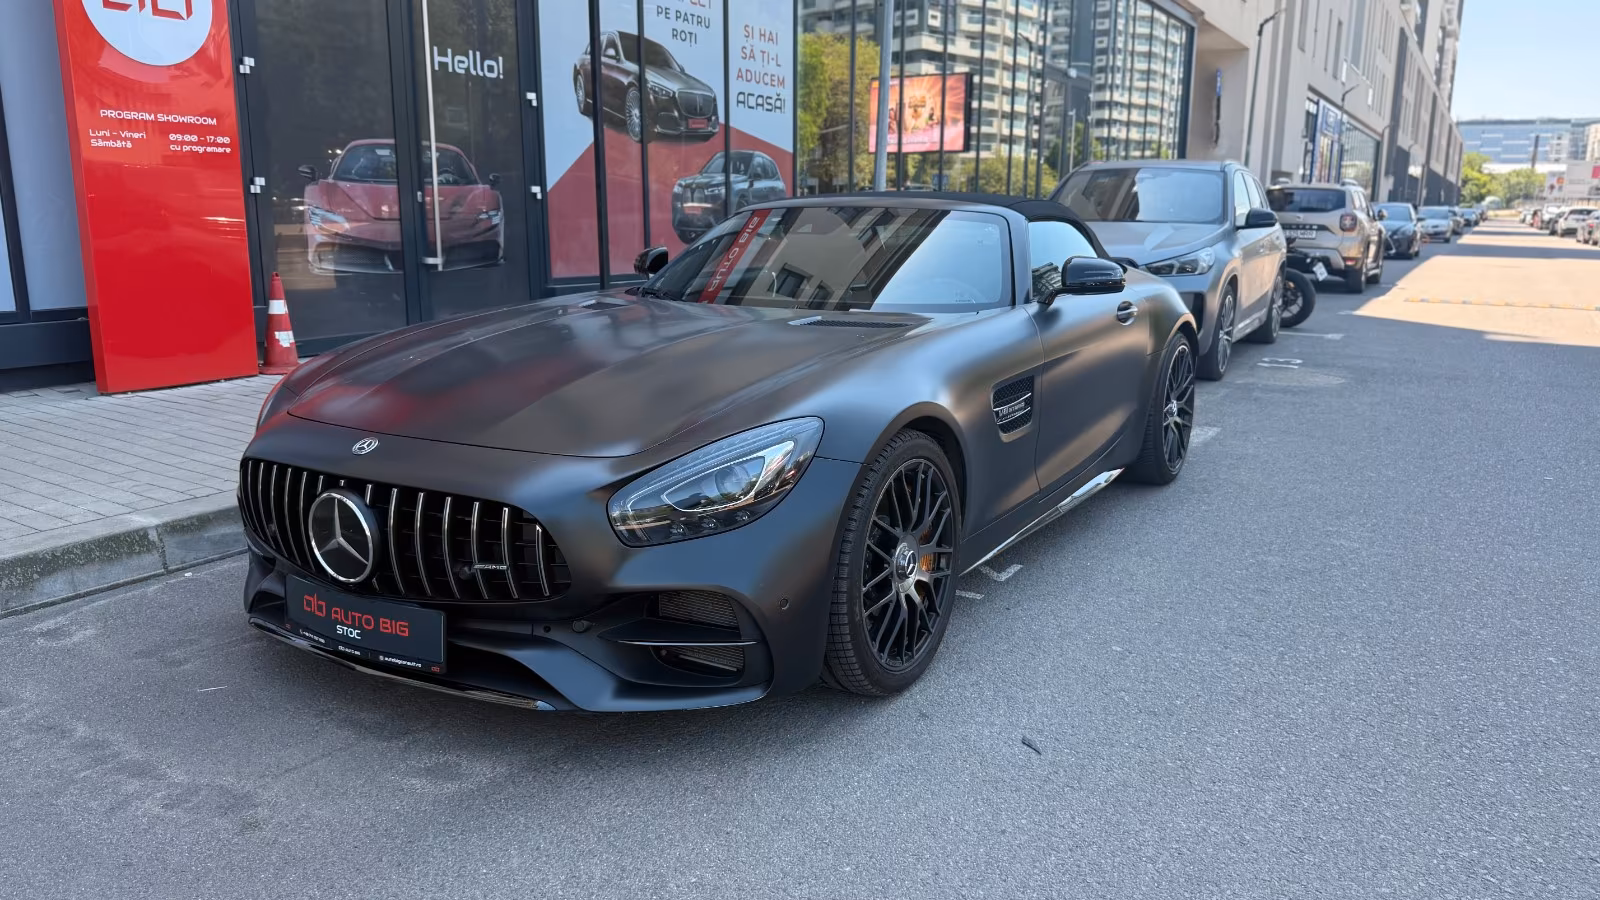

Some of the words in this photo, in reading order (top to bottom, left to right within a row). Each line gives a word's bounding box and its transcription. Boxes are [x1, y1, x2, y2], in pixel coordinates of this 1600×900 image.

[656, 5, 671, 20] PE
[675, 10, 711, 29] PATRU
[671, 27, 697, 47] ROȚI
[743, 24, 754, 42] ȘI
[759, 27, 778, 46] HAI
[433, 46, 504, 79] Hello!
[741, 44, 756, 62] SĂ
[736, 67, 785, 89] ADUCEM
[736, 91, 786, 114] ACASĂ!
[100, 109, 155, 121] PROGRAM
[157, 114, 217, 126] SHOWROOM
[89, 129, 110, 137] Luni
[119, 130, 146, 140] Vineri
[169, 133, 198, 142] 09:00
[206, 136, 230, 144] 17:00
[183, 144, 231, 154] programare
[331, 607, 375, 630] AUTO
[379, 617, 409, 637] BIG
[336, 625, 361, 639] STOC
